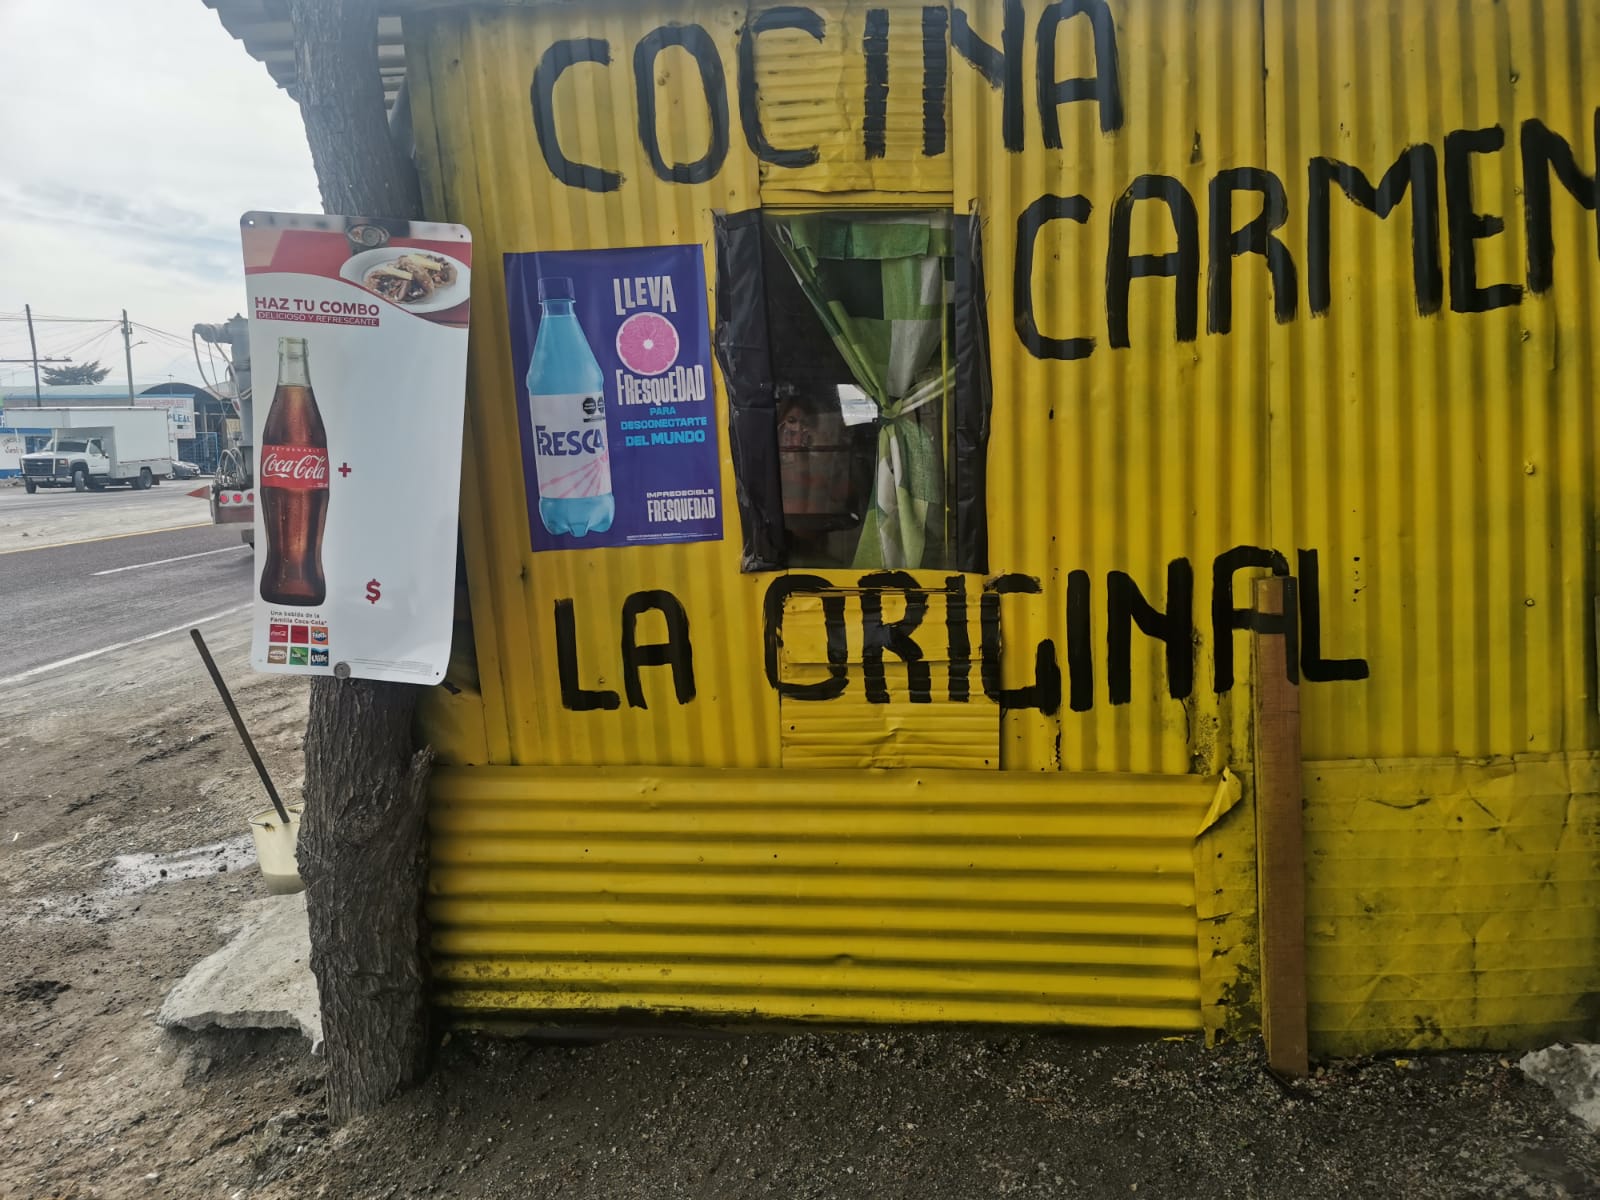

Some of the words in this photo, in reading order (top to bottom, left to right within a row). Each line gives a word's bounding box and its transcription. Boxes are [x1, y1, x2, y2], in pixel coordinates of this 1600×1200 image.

[530, 0, 1124, 193] COCINA
[1012, 107, 1600, 361] CARMEN
[255, 297, 290, 311] HAZ
[293, 299, 315, 312] TU
[319, 301, 380, 316] COMBO
[613, 275, 678, 315] LLEVA
[258, 311, 306, 321] DELICIOSO
[307, 314, 316, 322] Y
[316, 315, 378, 327] REFRESCANTE
[615, 364, 707, 406] FRESQUEDAD
[620, 416, 708, 430] DESCONECTARTE
[649, 406, 676, 417] PARA
[535, 425, 605, 456] FRESCA
[625, 434, 650, 448] DEL
[651, 430, 706, 446] MUNDO
[262, 453, 327, 480] Coca-Cola
[646, 488, 715, 499] IMPREDECIBLE
[647, 497, 716, 523] FRESQUEDAD
[365, 578, 382, 605] $
[555, 588, 697, 712] LA
[763, 545, 1370, 717] ORIGINAL
